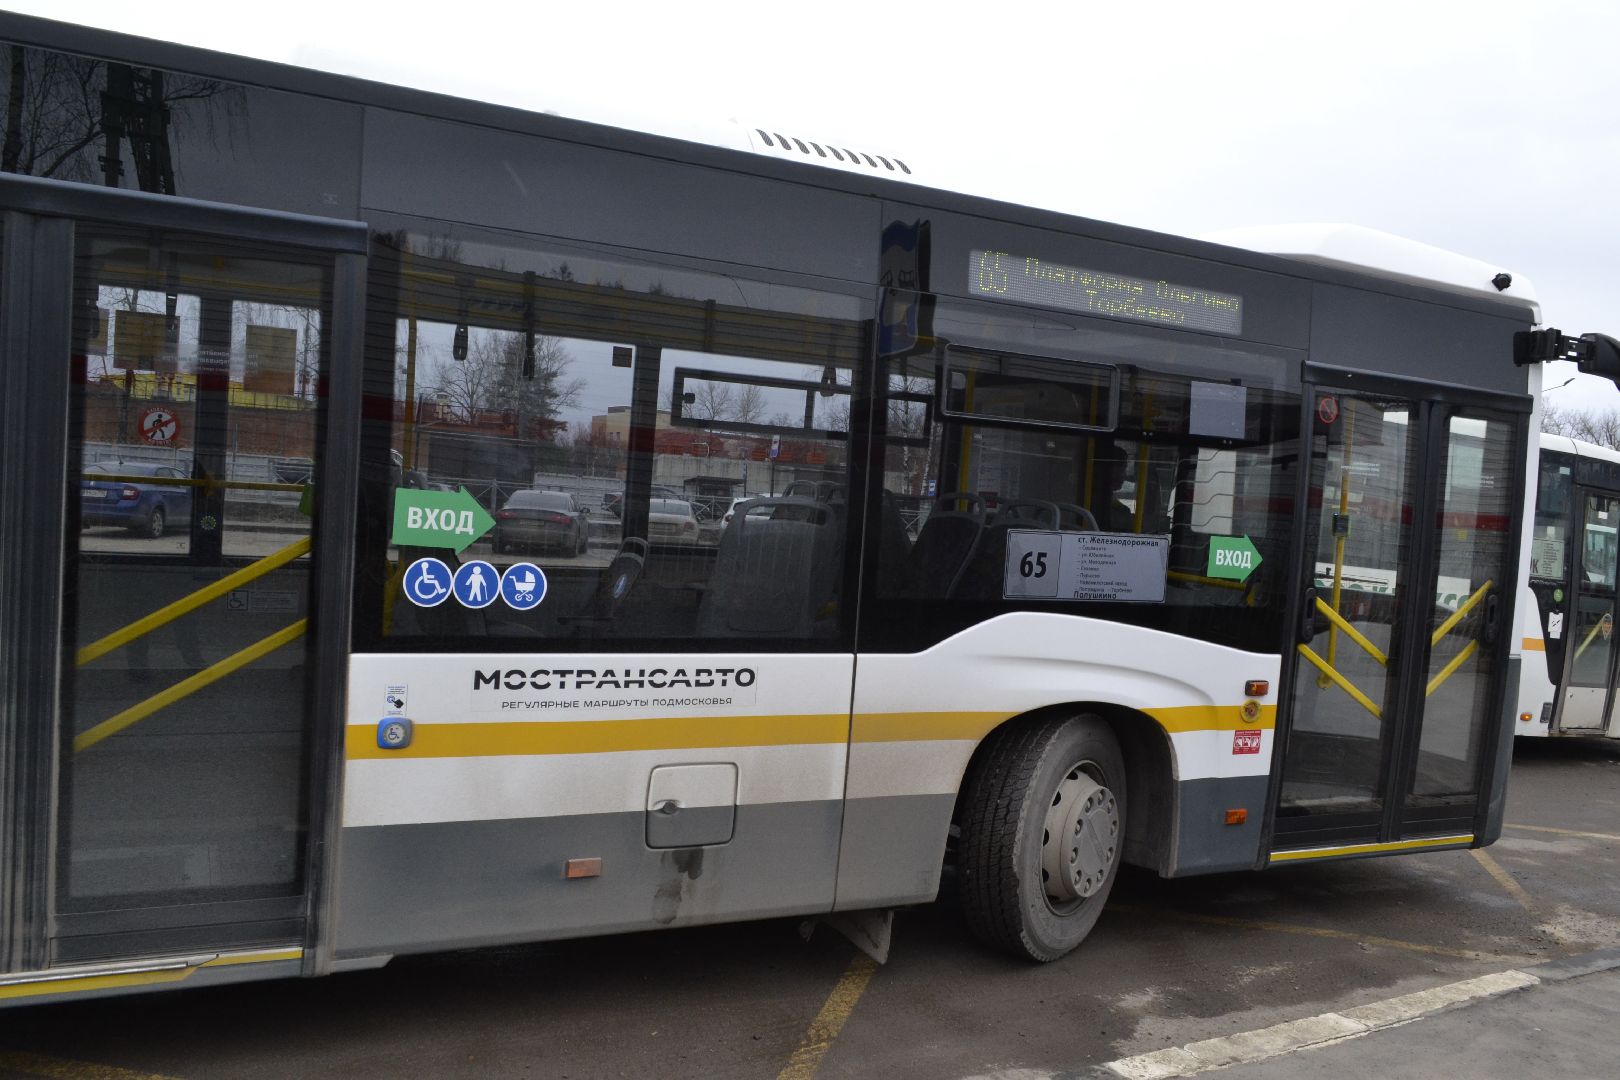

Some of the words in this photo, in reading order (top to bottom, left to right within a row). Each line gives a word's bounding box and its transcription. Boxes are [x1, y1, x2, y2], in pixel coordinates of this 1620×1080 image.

[979, 250, 1009, 293] 65
[1025, 257, 1143, 294] Платформа
[1156, 280, 1239, 312] Ольгино
[1085, 289, 1185, 325] Торбеево
[407, 506, 475, 535] ВХОД
[1089, 536, 1159, 547] Железнодорожная
[1019, 550, 1048, 579] 65
[1215, 549, 1252, 569] ВХОД
[1073, 590, 1117, 600] Полушкино
[473, 667, 756, 690] МОСТРАНСАВТО
[502, 700, 580, 709] РЕГУЛЯРНЫЕ
[583, 699, 649, 708] МАРШРУТЫ
[652, 697, 732, 707] ПОДМОСКОВЬЯ
